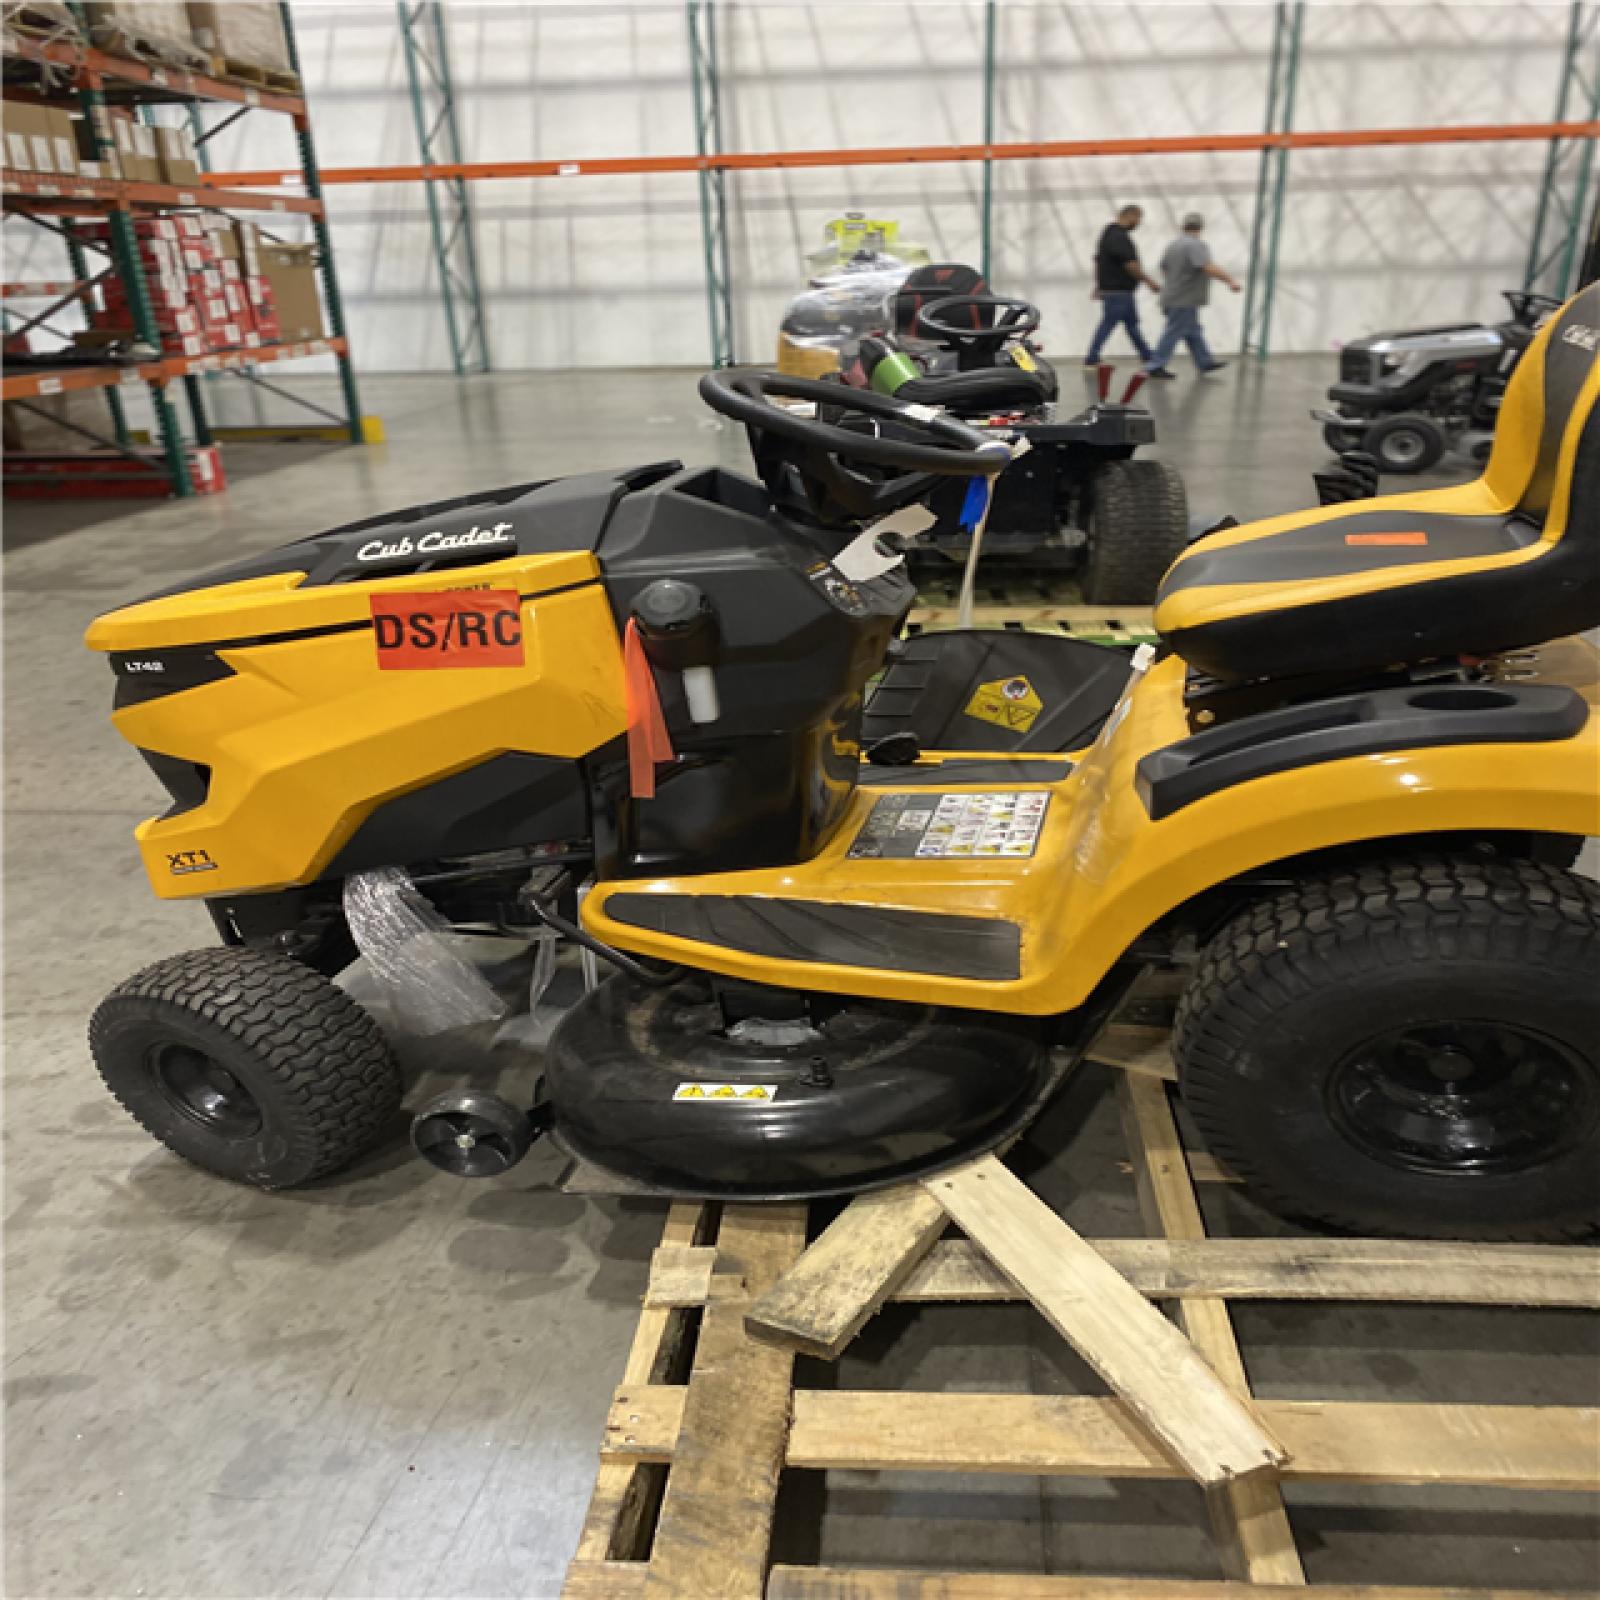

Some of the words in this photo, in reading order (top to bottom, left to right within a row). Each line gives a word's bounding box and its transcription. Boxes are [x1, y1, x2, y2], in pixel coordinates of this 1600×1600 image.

[357, 536, 413, 560] Cub
[417, 522, 513, 551] Cadet
[375, 610, 521, 651] DS/RC
[166, 849, 210, 867] XT1
